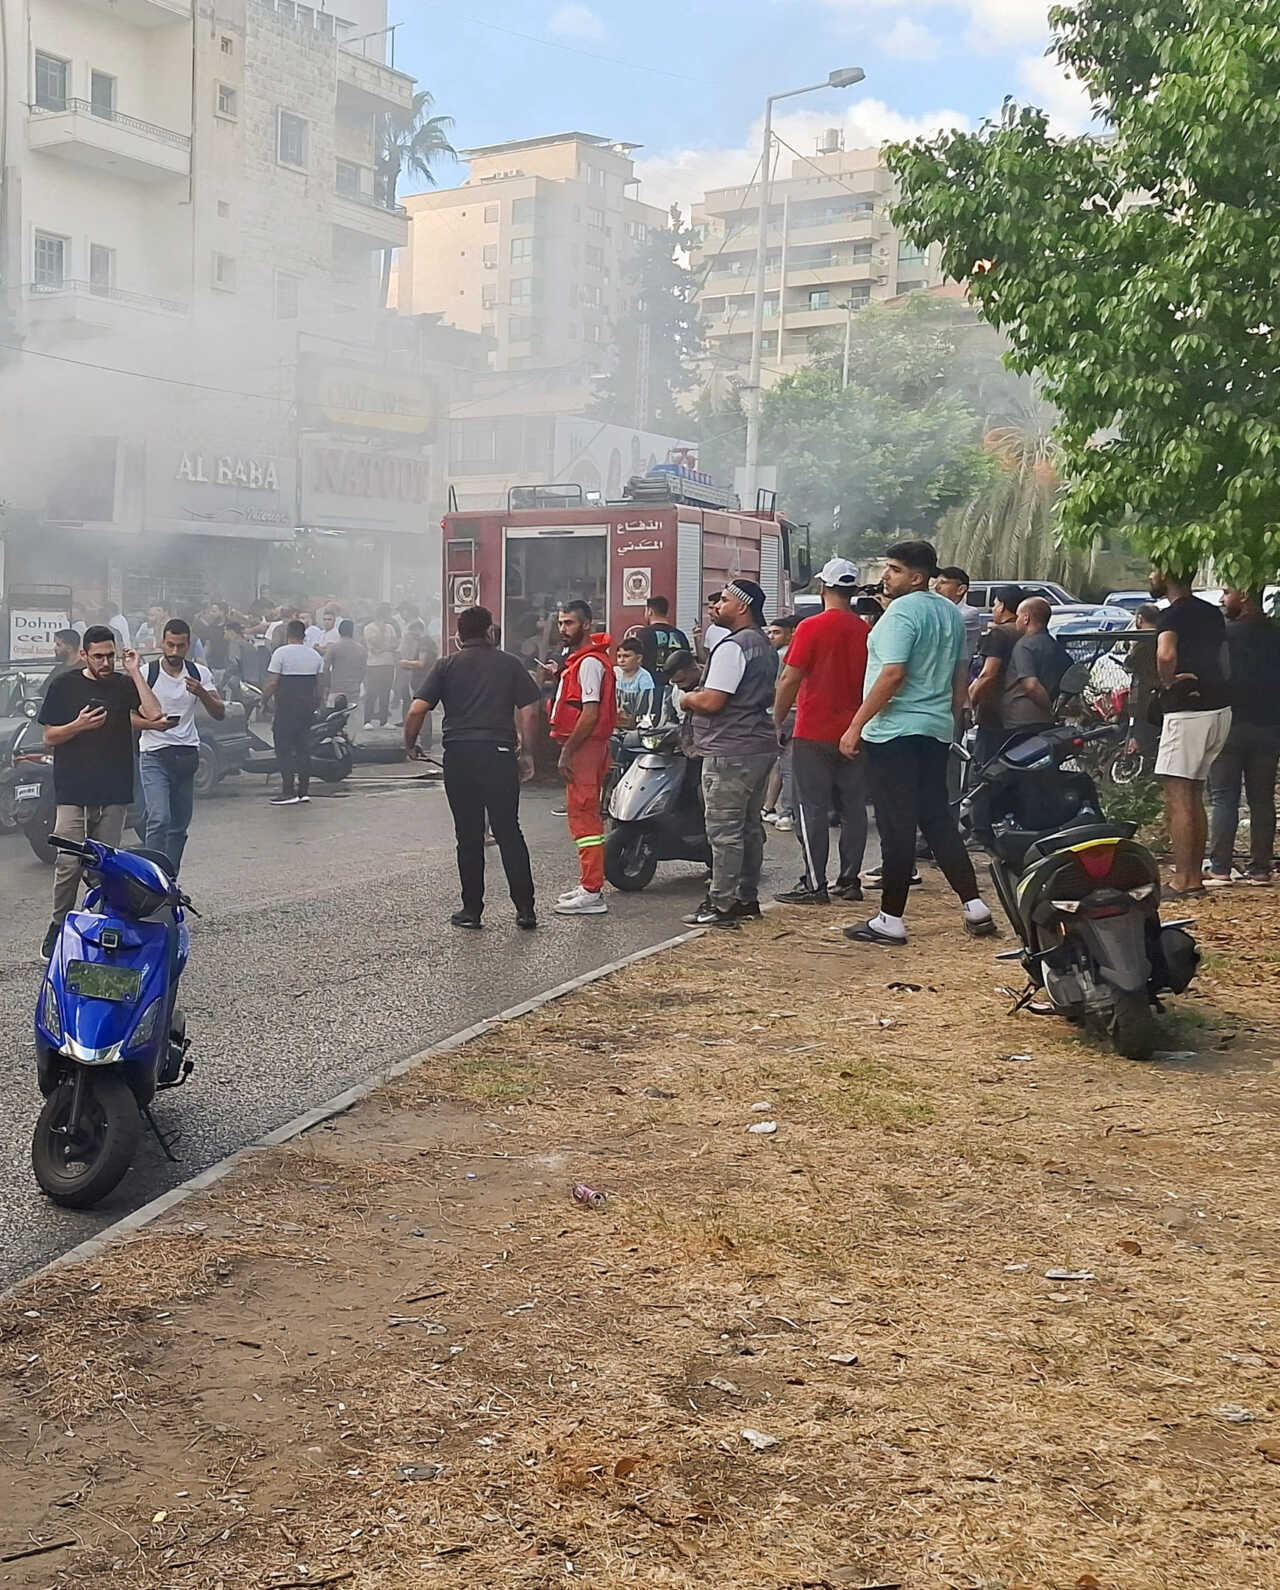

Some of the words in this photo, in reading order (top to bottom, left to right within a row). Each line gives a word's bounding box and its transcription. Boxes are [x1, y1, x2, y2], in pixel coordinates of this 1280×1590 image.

[176, 451, 209, 482] AL
[216, 454, 281, 490] BABA
[15, 616, 62, 629] Dohni
